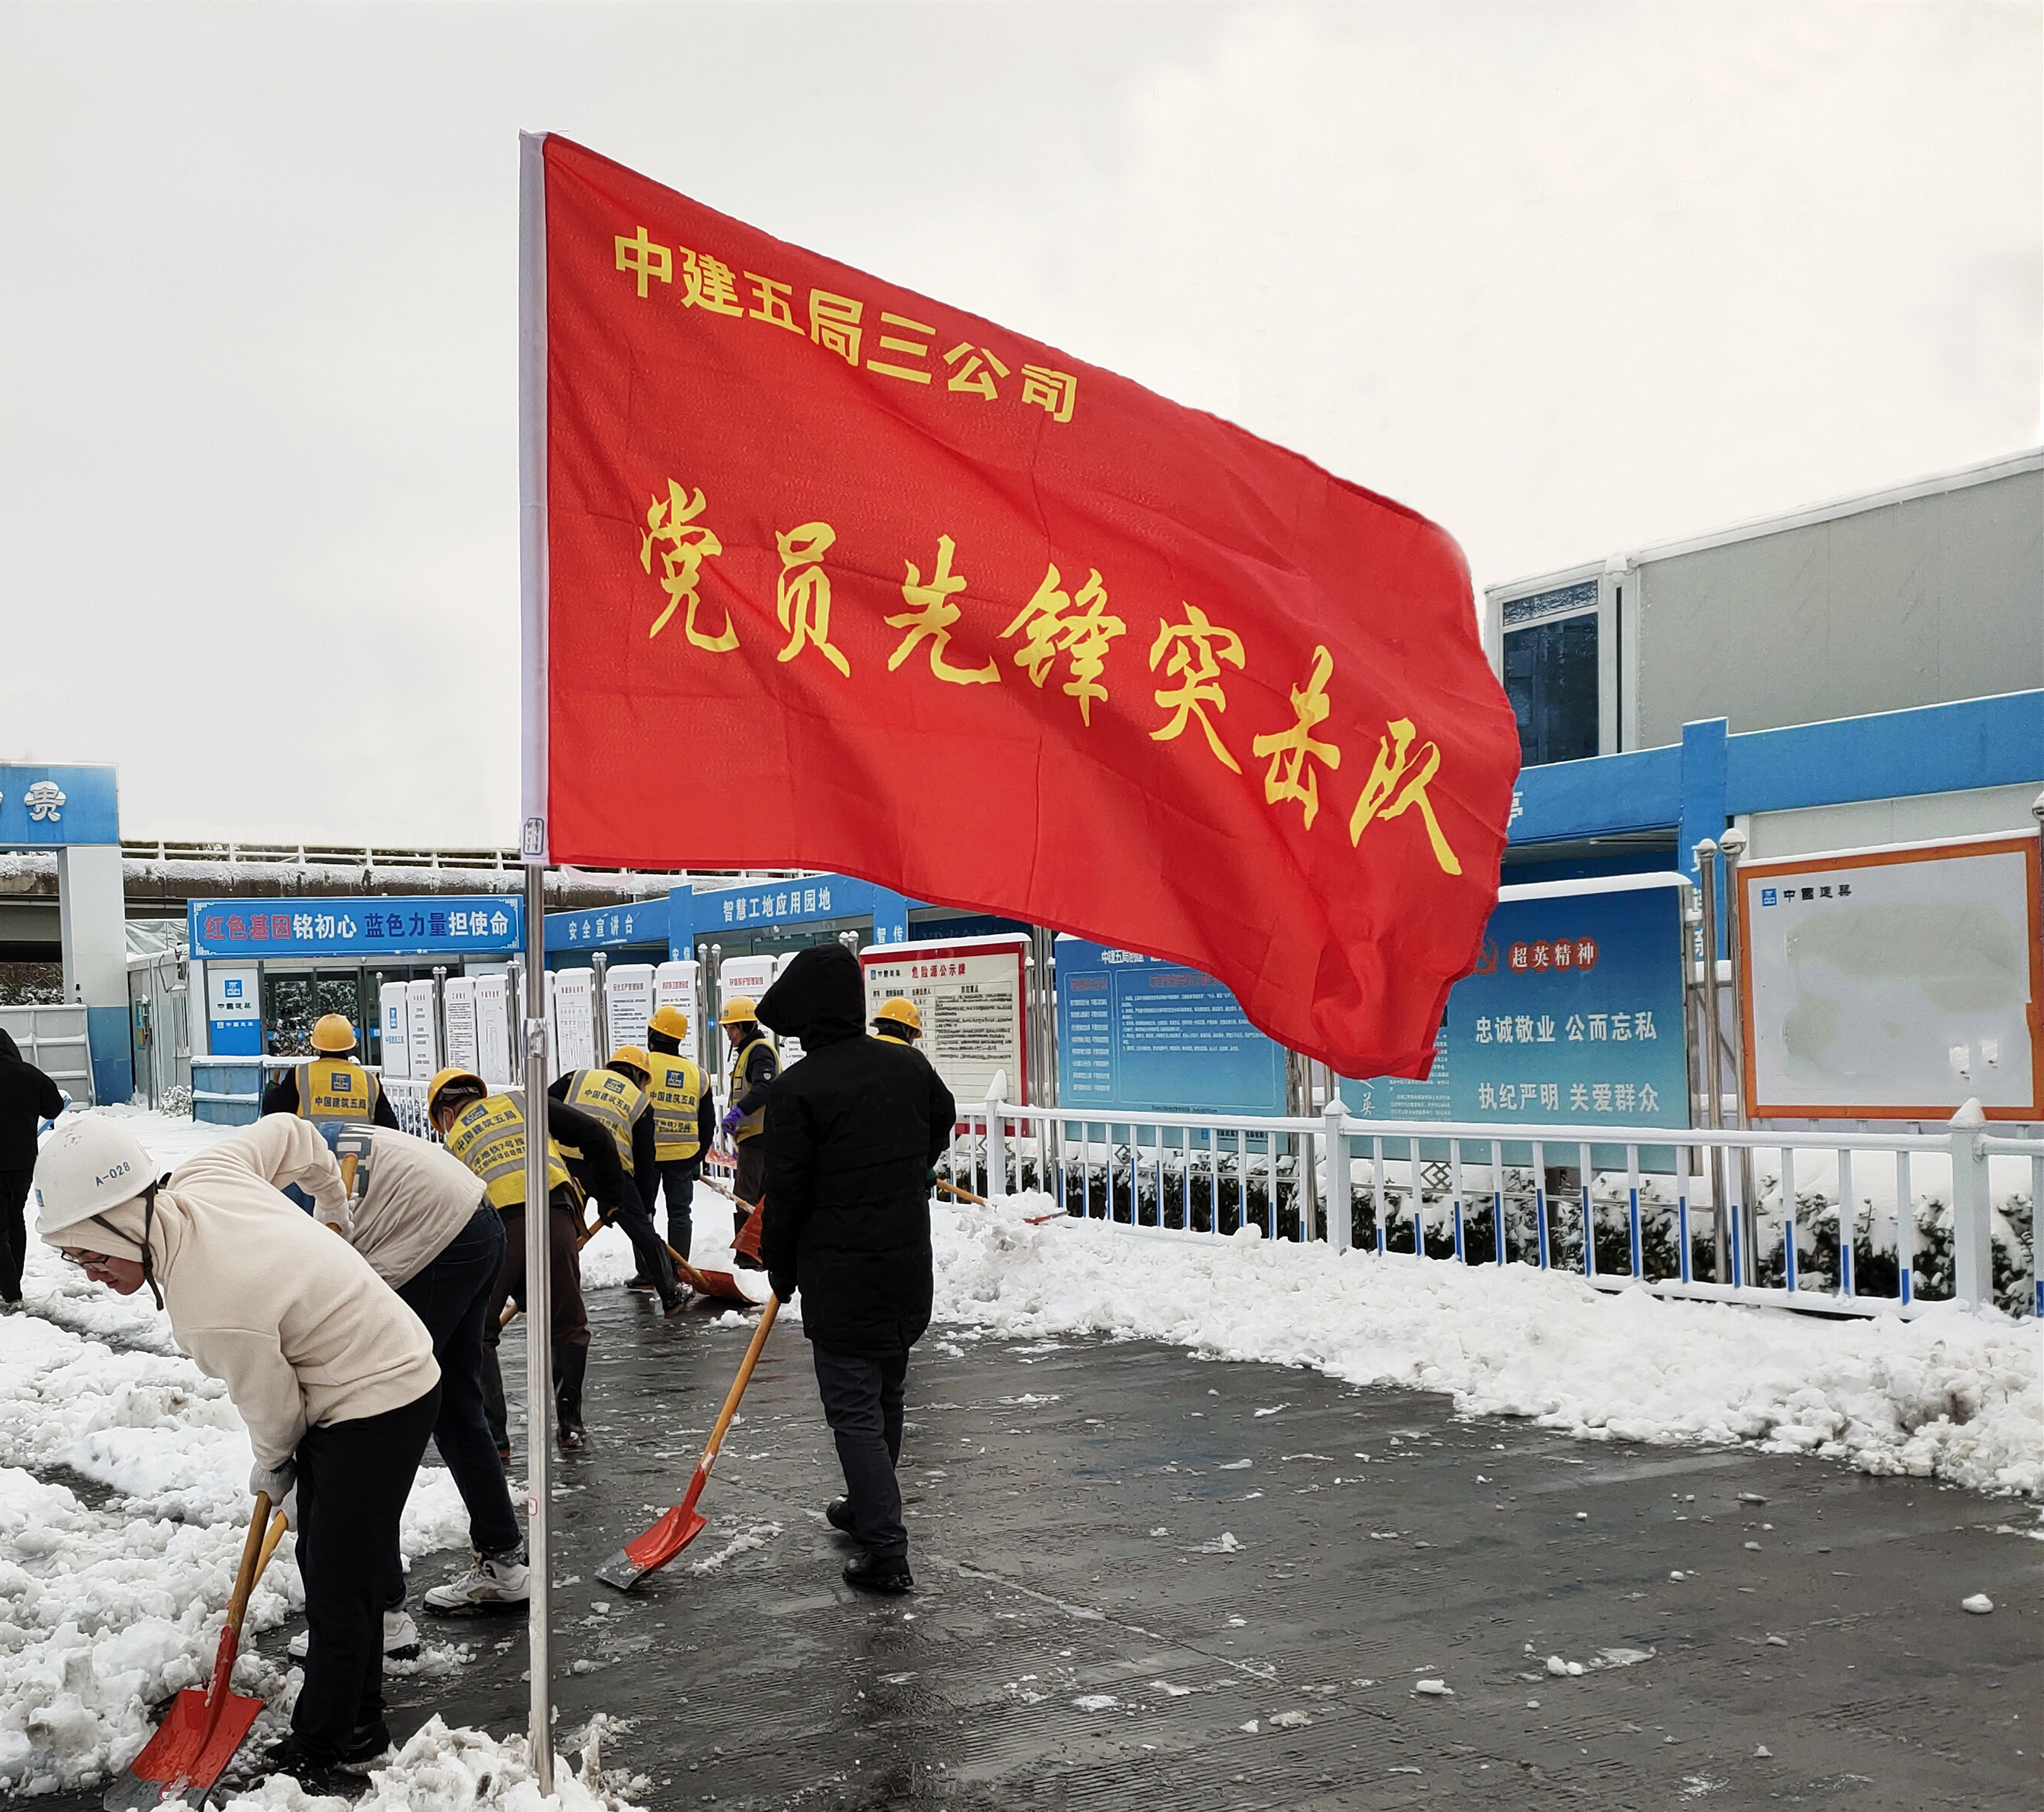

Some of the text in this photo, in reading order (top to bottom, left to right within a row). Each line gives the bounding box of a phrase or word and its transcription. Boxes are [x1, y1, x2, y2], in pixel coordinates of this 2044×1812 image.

[614, 225, 1077, 424] 中建五局三公司
[639, 476, 1462, 876] 党员先锋突击队
[723, 886, 831, 923] 智慧工地应用园地
[203, 911, 509, 941] 红色基因铭初心 蓝色力量担使命
[568, 914, 634, 941] 安全宣讲台
[1512, 942, 1595, 968] 超英精神
[911, 963, 966, 980] 危险源公示牌
[1475, 1011, 1658, 1044] 忠诚敬业 公而忘私
[315, 1096, 367, 1110] 中国建筑五局
[584, 1088, 632, 1113] 中国建筑五局
[650, 1091, 696, 1106] 中国建筑五局
[1478, 1082, 1660, 1113] 执纪严明 关爱群众
[456, 1110, 518, 1152] 中国建筑五局
[95, 1161, 131, 1188] A-028
